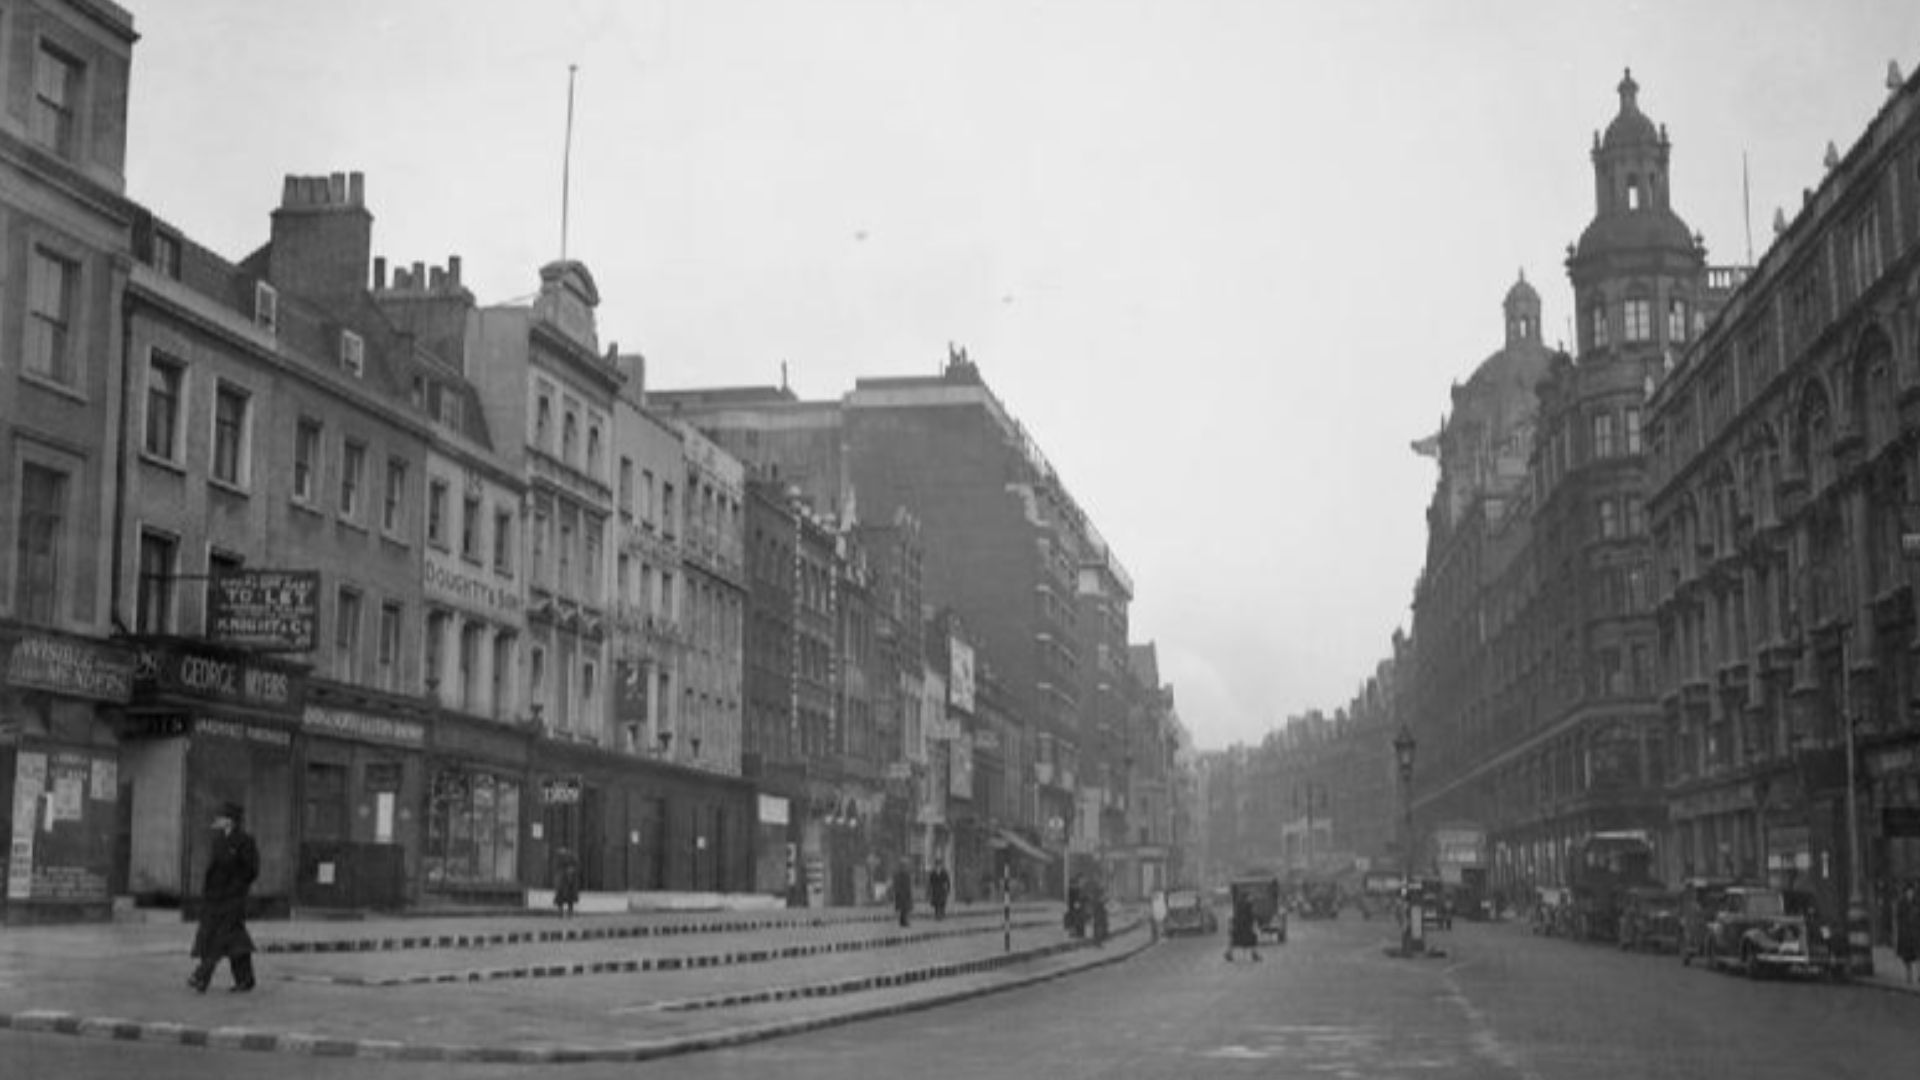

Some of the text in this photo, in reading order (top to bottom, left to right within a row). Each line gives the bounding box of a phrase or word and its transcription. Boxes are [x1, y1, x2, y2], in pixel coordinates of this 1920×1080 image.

[225, 589, 309, 605] TO LET
[425, 560, 487, 600] DOUGHTY
[180, 655, 237, 696] GEORGE
